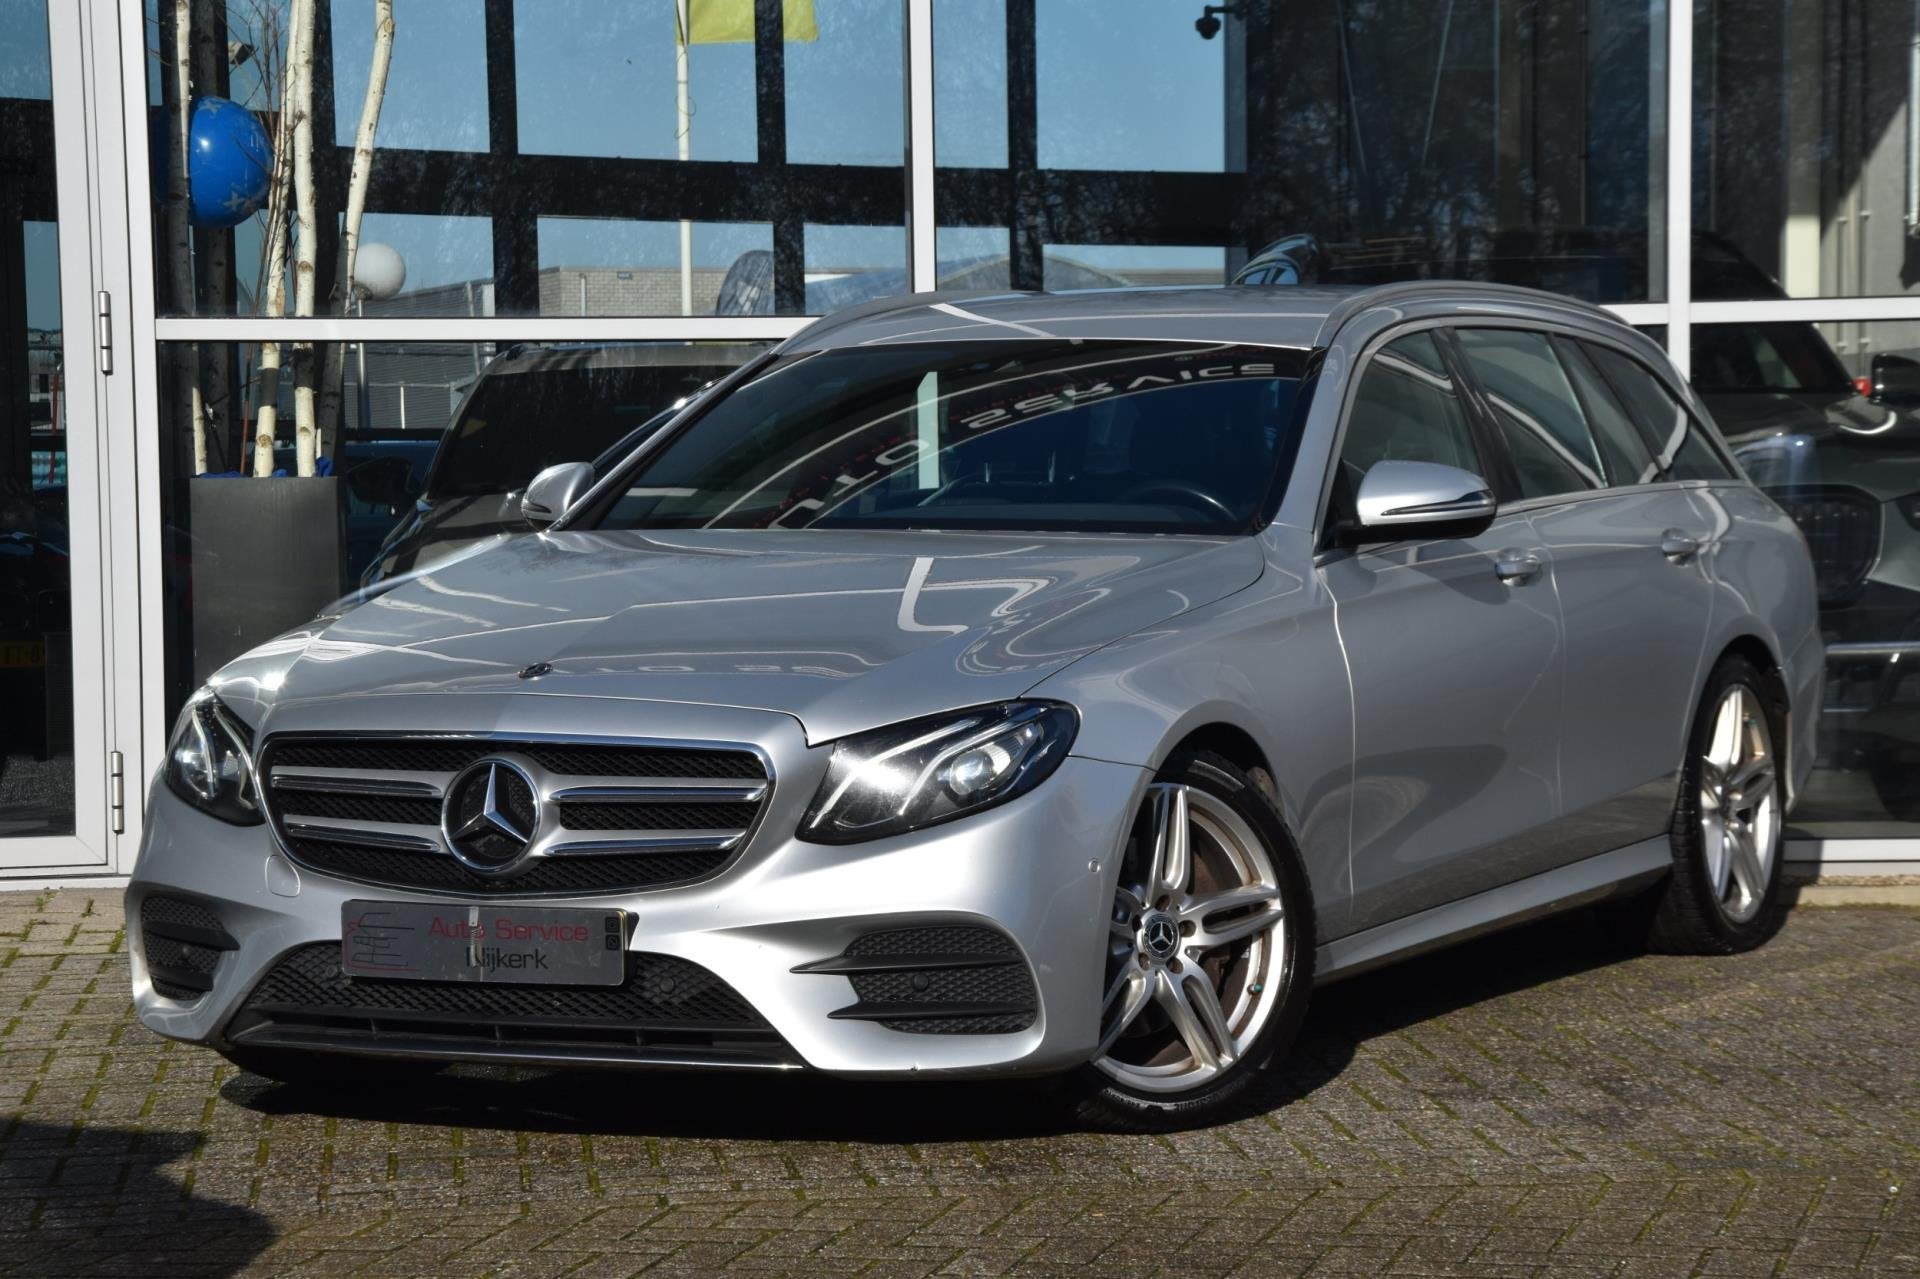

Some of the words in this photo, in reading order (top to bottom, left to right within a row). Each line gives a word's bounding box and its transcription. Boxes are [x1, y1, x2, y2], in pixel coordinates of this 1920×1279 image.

[428, 916, 486, 941] Auto
[495, 917, 589, 942] Service
[466, 946, 549, 973] Nijkerk
